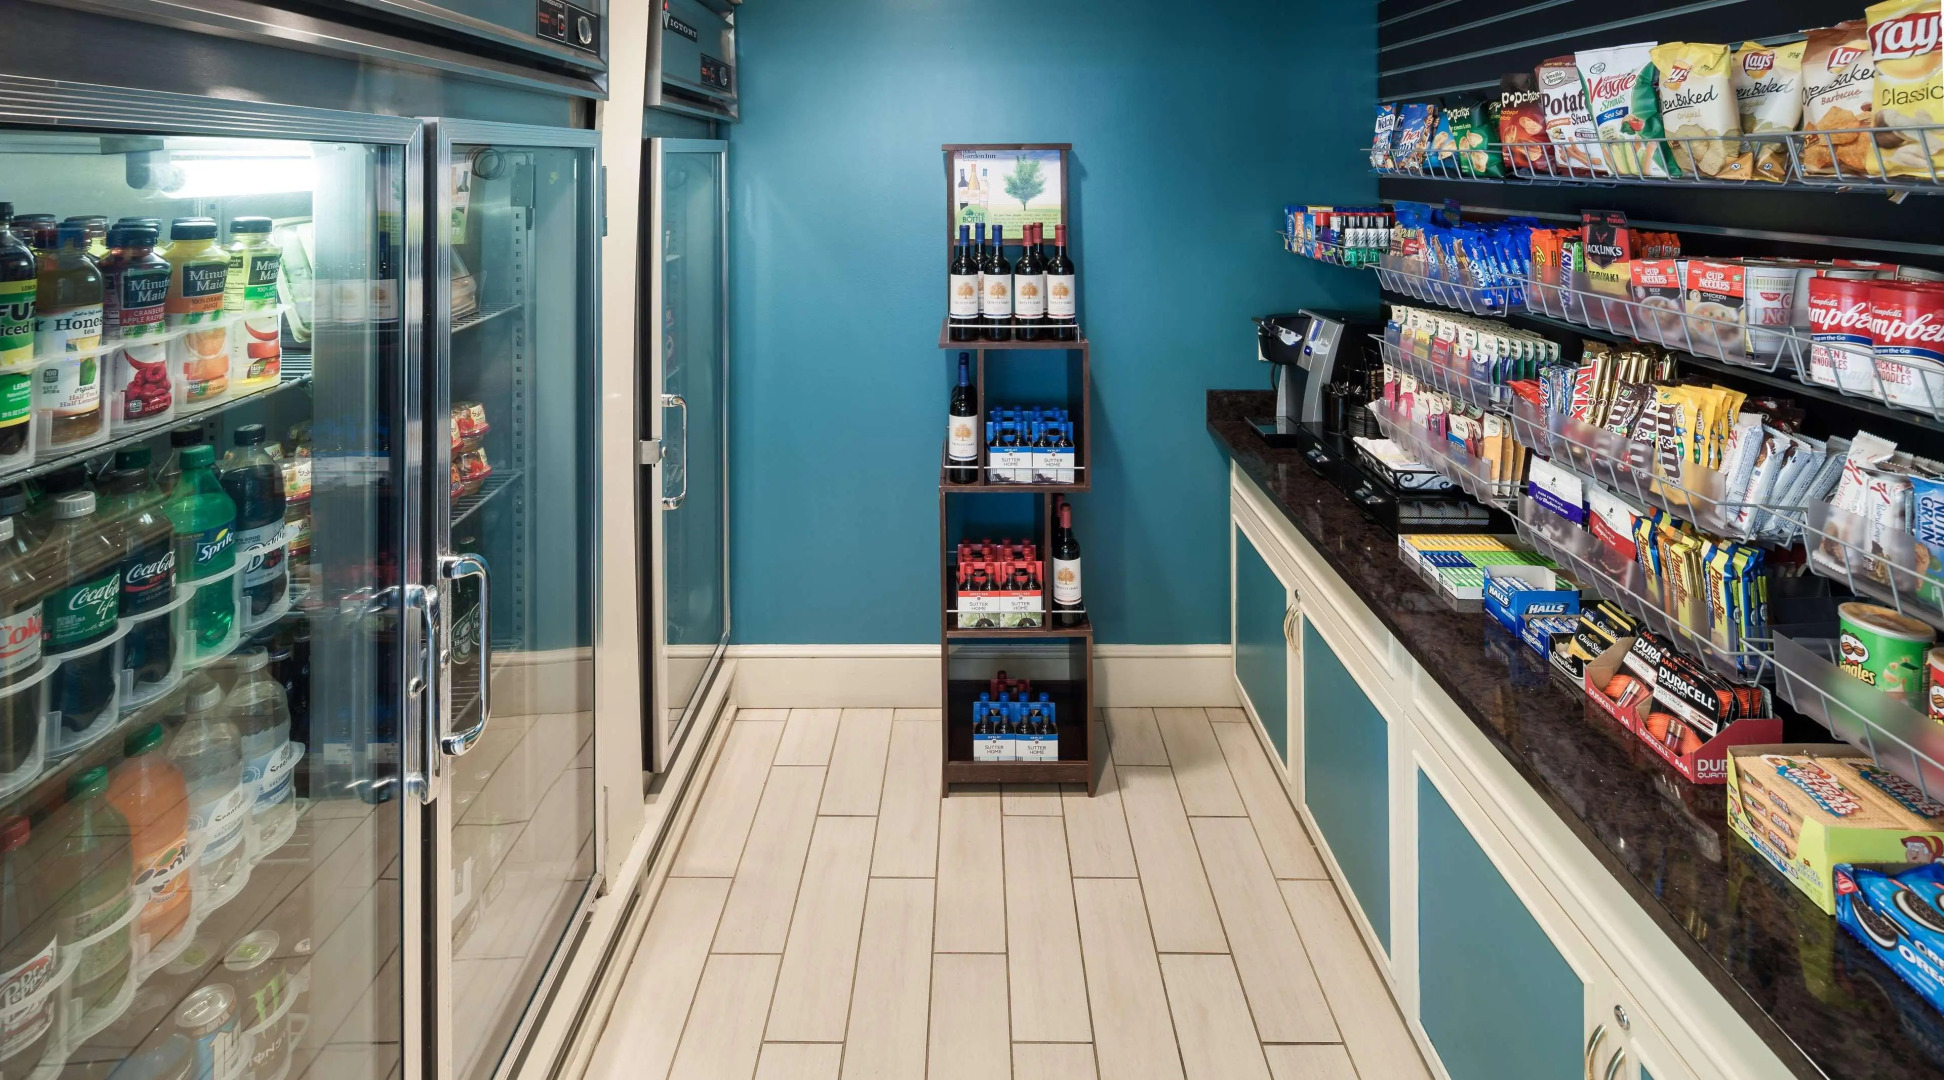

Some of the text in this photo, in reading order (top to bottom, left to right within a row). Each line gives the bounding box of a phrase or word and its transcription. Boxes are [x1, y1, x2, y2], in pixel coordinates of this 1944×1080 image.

[1587, 74, 1637, 104] Veggie
[1821, 88, 1863, 106] Barbecue
[1881, 83, 1944, 107] Classic
[1645, 267, 1660, 276] CUP
[1706, 272, 1724, 281] CUP
[196, 279, 225, 292] Maid
[1699, 279, 1731, 292] NOODLES
[137, 289, 166, 303] Maid
[1702, 292, 1727, 300] CHICKEN
[122, 315, 145, 325] APPLE
[1841, 350, 1847, 360] &
[1880, 371, 1912, 386] OODLES
[1905, 366, 1912, 375] &
[1572, 359, 1597, 422] TWIX
[1920, 496, 1937, 546] GRAIN
[1670, 550, 1688, 608] PowerBar
[1488, 586, 1510, 606] HALLS
[1710, 566, 1727, 625] PowerBar
[1528, 604, 1565, 614] HALLS
[1552, 650, 1578, 675] ChapStick
[1661, 658, 1674, 669] AAA
[1658, 677, 1687, 699] QUANTUM
[1658, 666, 1716, 711] DURACELL
[1588, 687, 1630, 727] DURACELL AA
[1639, 728, 1690, 774] DURACELL AAA
[1784, 772, 1829, 810] VANILLA
